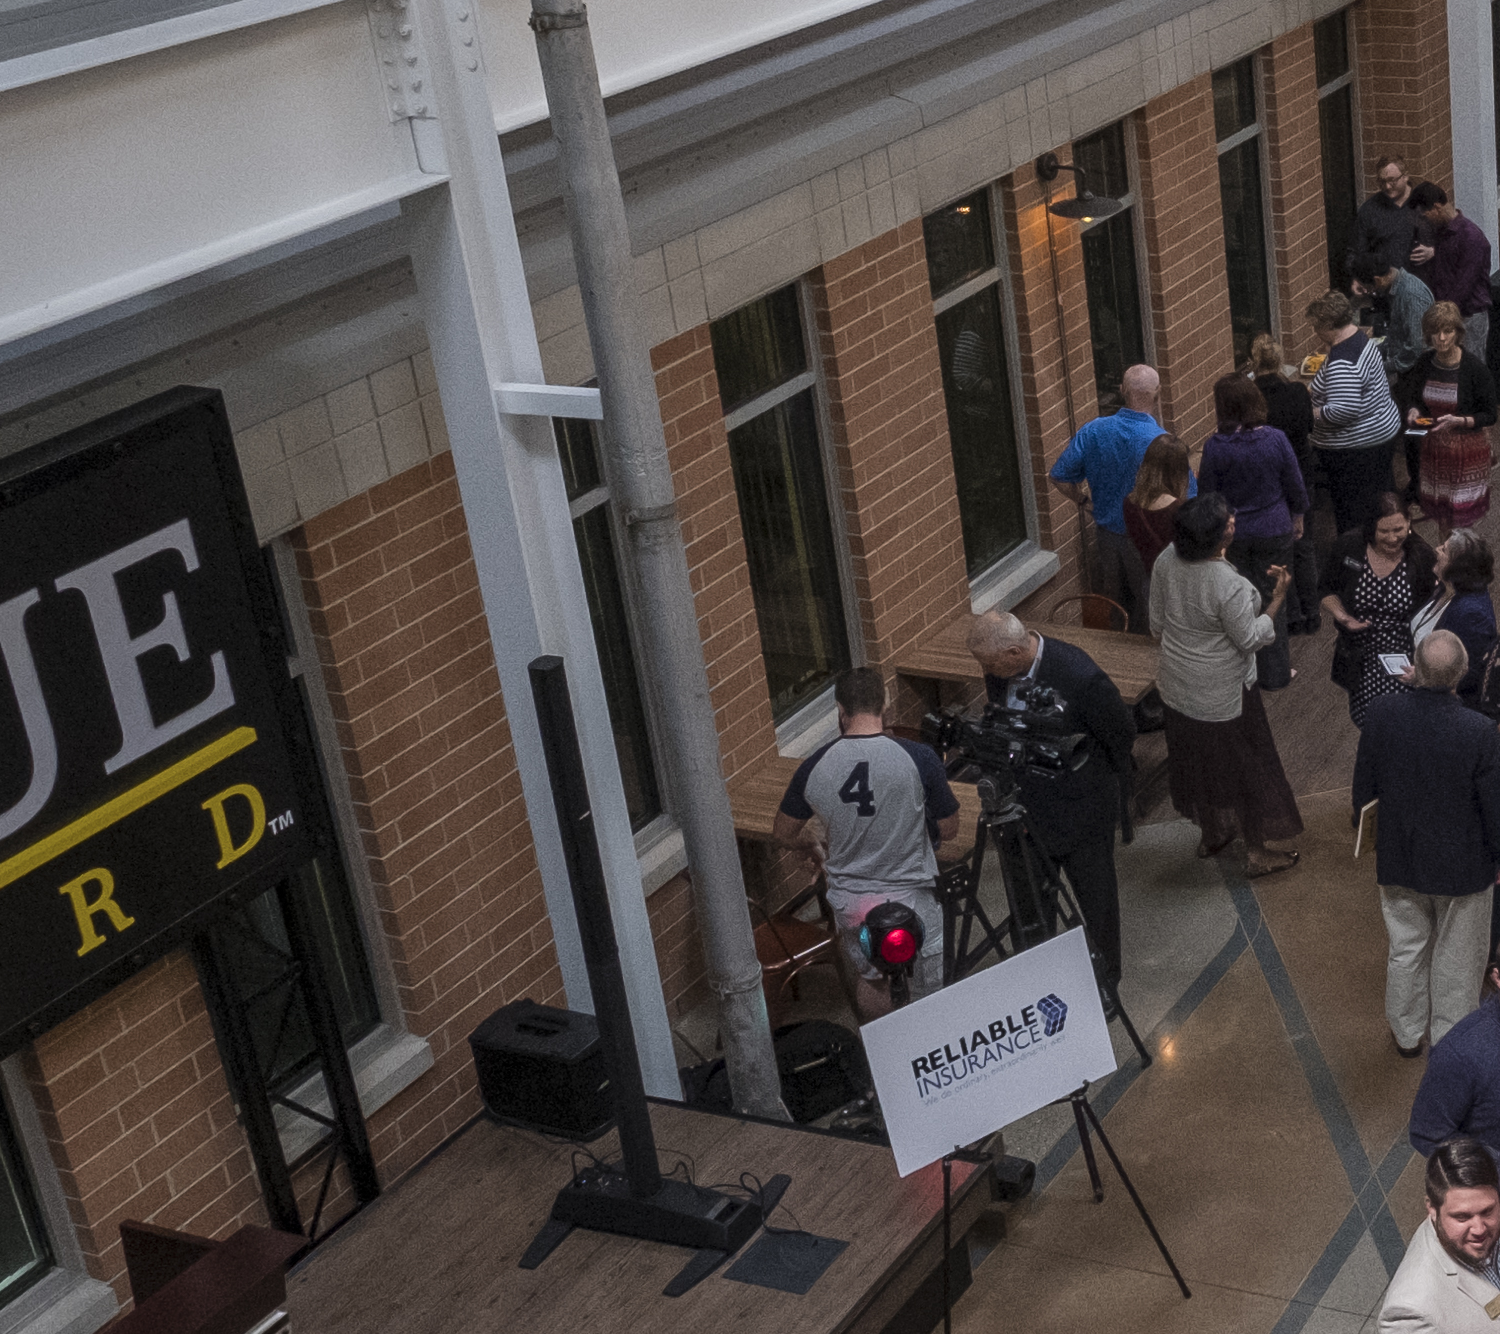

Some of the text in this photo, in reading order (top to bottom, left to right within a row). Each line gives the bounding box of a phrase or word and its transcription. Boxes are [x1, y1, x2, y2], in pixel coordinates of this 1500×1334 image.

[838, 761, 876, 818] 4
[911, 1004, 1038, 1079] RELIABLE
[916, 1024, 1042, 1098] INSURANCE
[923, 1095, 939, 1107] We
[941, 1089, 953, 1099] do
[954, 1073, 991, 1094] ordinary,
[990, 1043, 1048, 1076] extraordinarily
